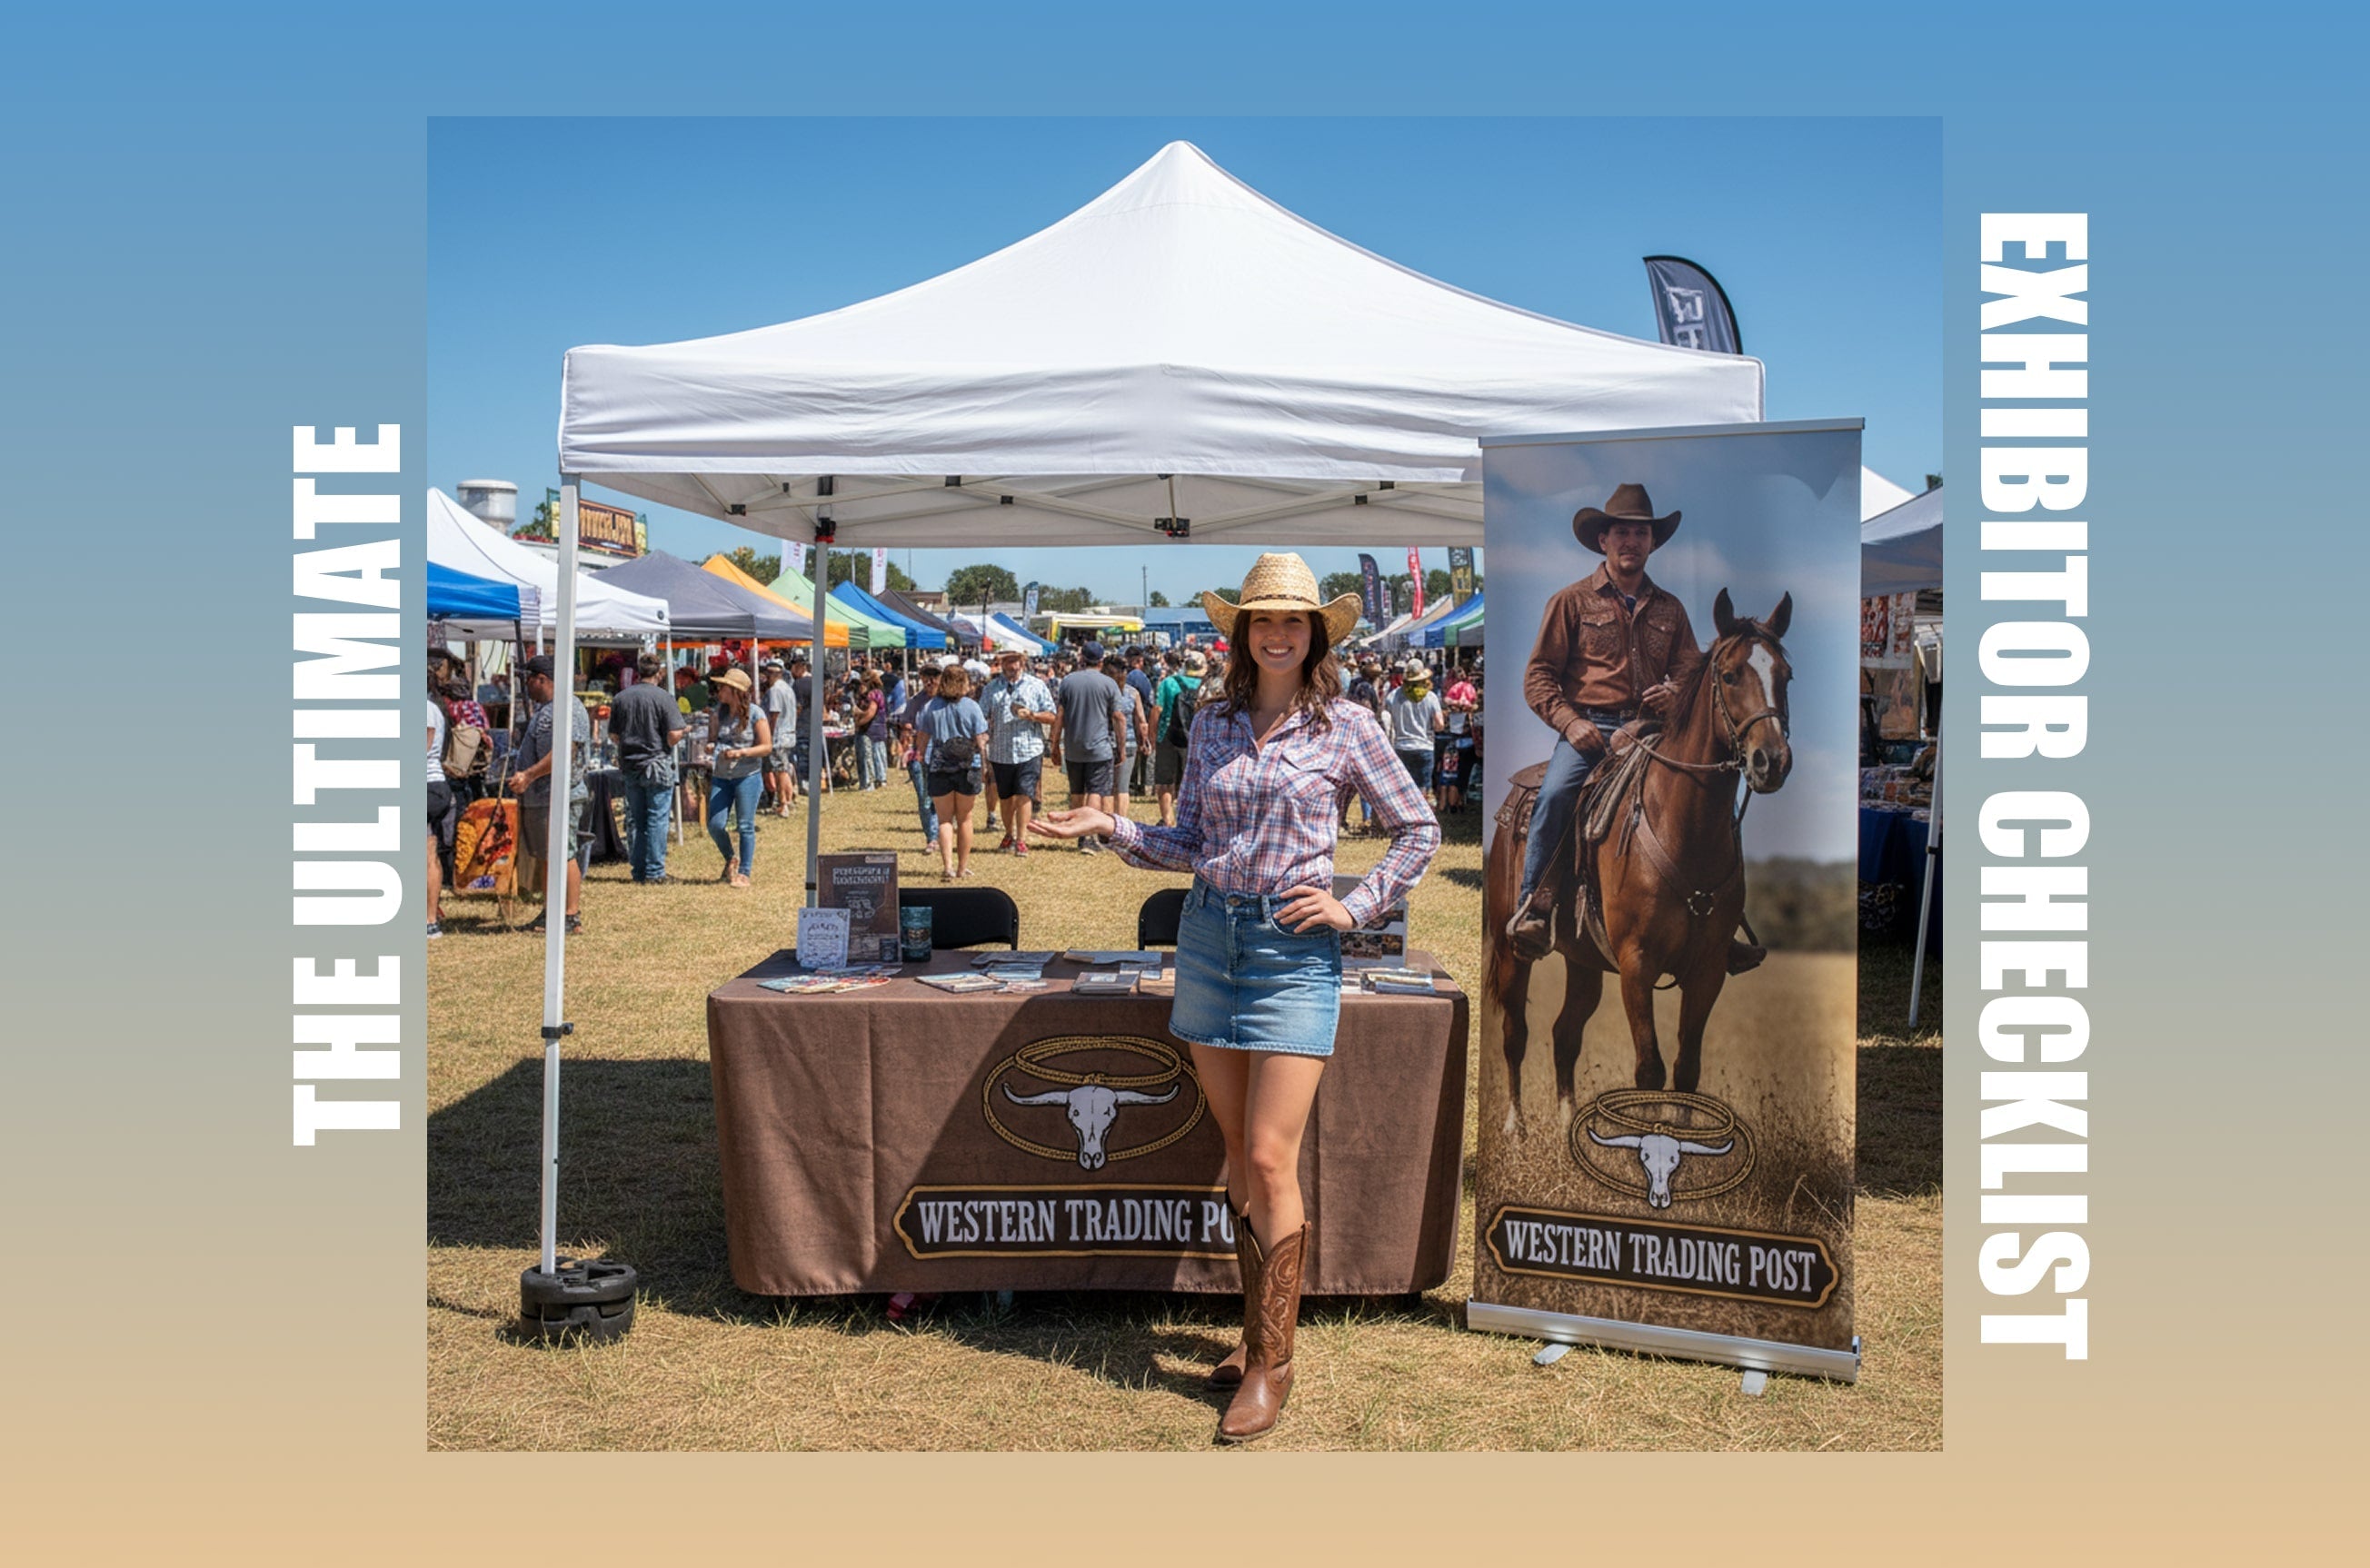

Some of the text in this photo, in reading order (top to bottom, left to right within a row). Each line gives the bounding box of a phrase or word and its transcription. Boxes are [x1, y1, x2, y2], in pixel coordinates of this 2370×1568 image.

[918, 1200, 1057, 1244] WESTERN
[1065, 1199, 1192, 1243] TRADING
[1504, 1220, 1817, 1293] WESTERN TRADING POST
